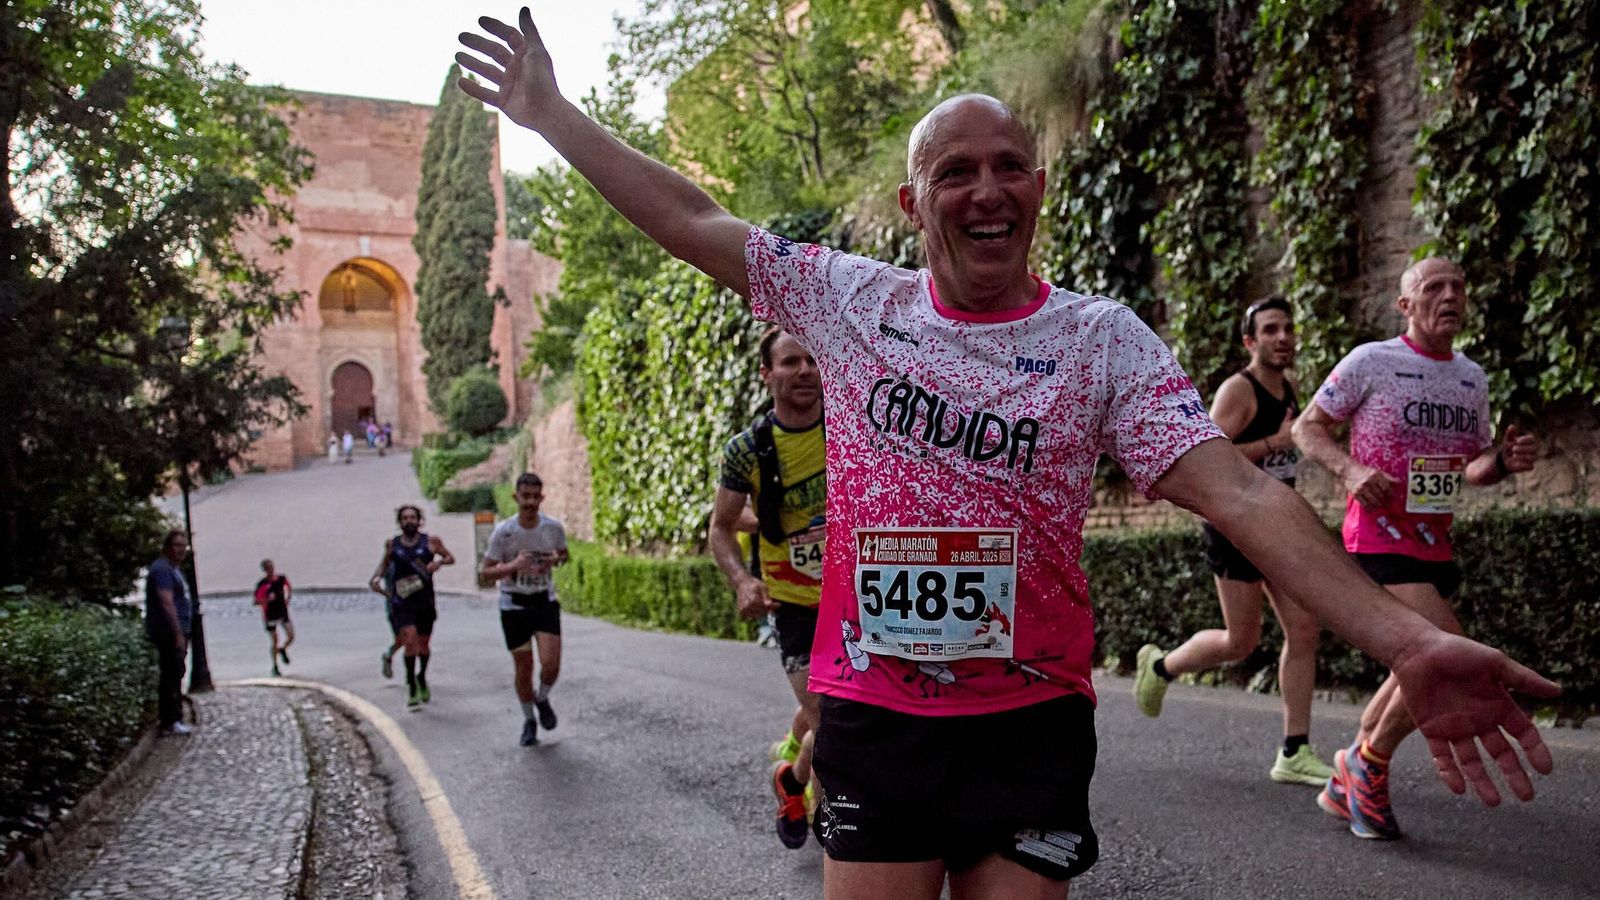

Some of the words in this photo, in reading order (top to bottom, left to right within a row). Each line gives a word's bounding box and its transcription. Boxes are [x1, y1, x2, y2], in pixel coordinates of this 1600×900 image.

[1015, 356, 1056, 376] PACO
[866, 374, 1040, 474] CÁNDIDA
[1403, 396, 1479, 433] CÁNDIDA
[1411, 473, 1462, 496] 3361
[879, 537, 899, 550] MEDIA
[900, 534, 938, 551] MARATÓN
[794, 543, 822, 567] 54
[878, 551, 898, 562] CIUDAD
[898, 551, 906, 562] DE
[906, 551, 938, 562] GRANADA
[950, 551, 959, 562] 26
[960, 551, 981, 562] ABRIL
[982, 551, 998, 562] 2025
[861, 570, 987, 621] 5485
